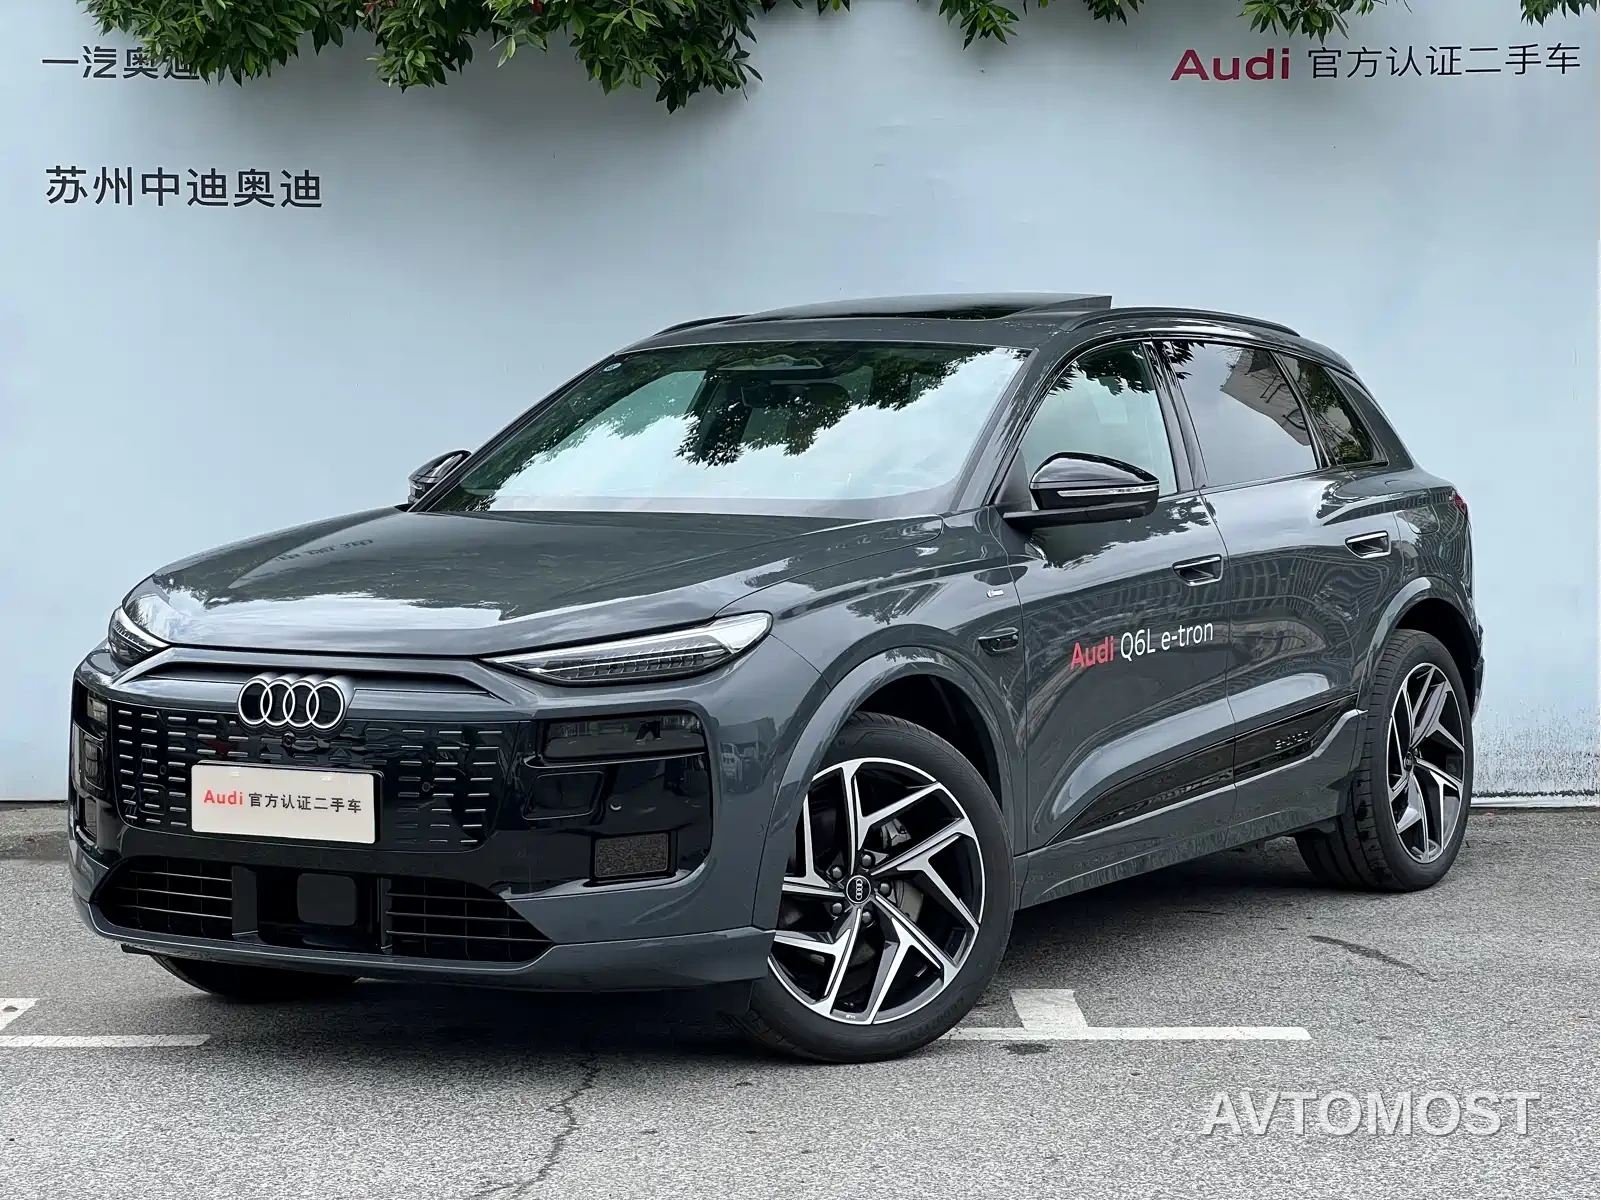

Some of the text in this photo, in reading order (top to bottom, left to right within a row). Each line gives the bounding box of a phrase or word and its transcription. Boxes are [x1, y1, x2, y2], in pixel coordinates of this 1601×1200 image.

[1170, 43, 1581, 81] Audi 官方认证二手车
[45, 165, 323, 208] 苏州中迪奥迪
[1070, 622, 1214, 670] Audi Q6L e-tron
[203, 789, 362, 813] Audi 官方认证二手车
